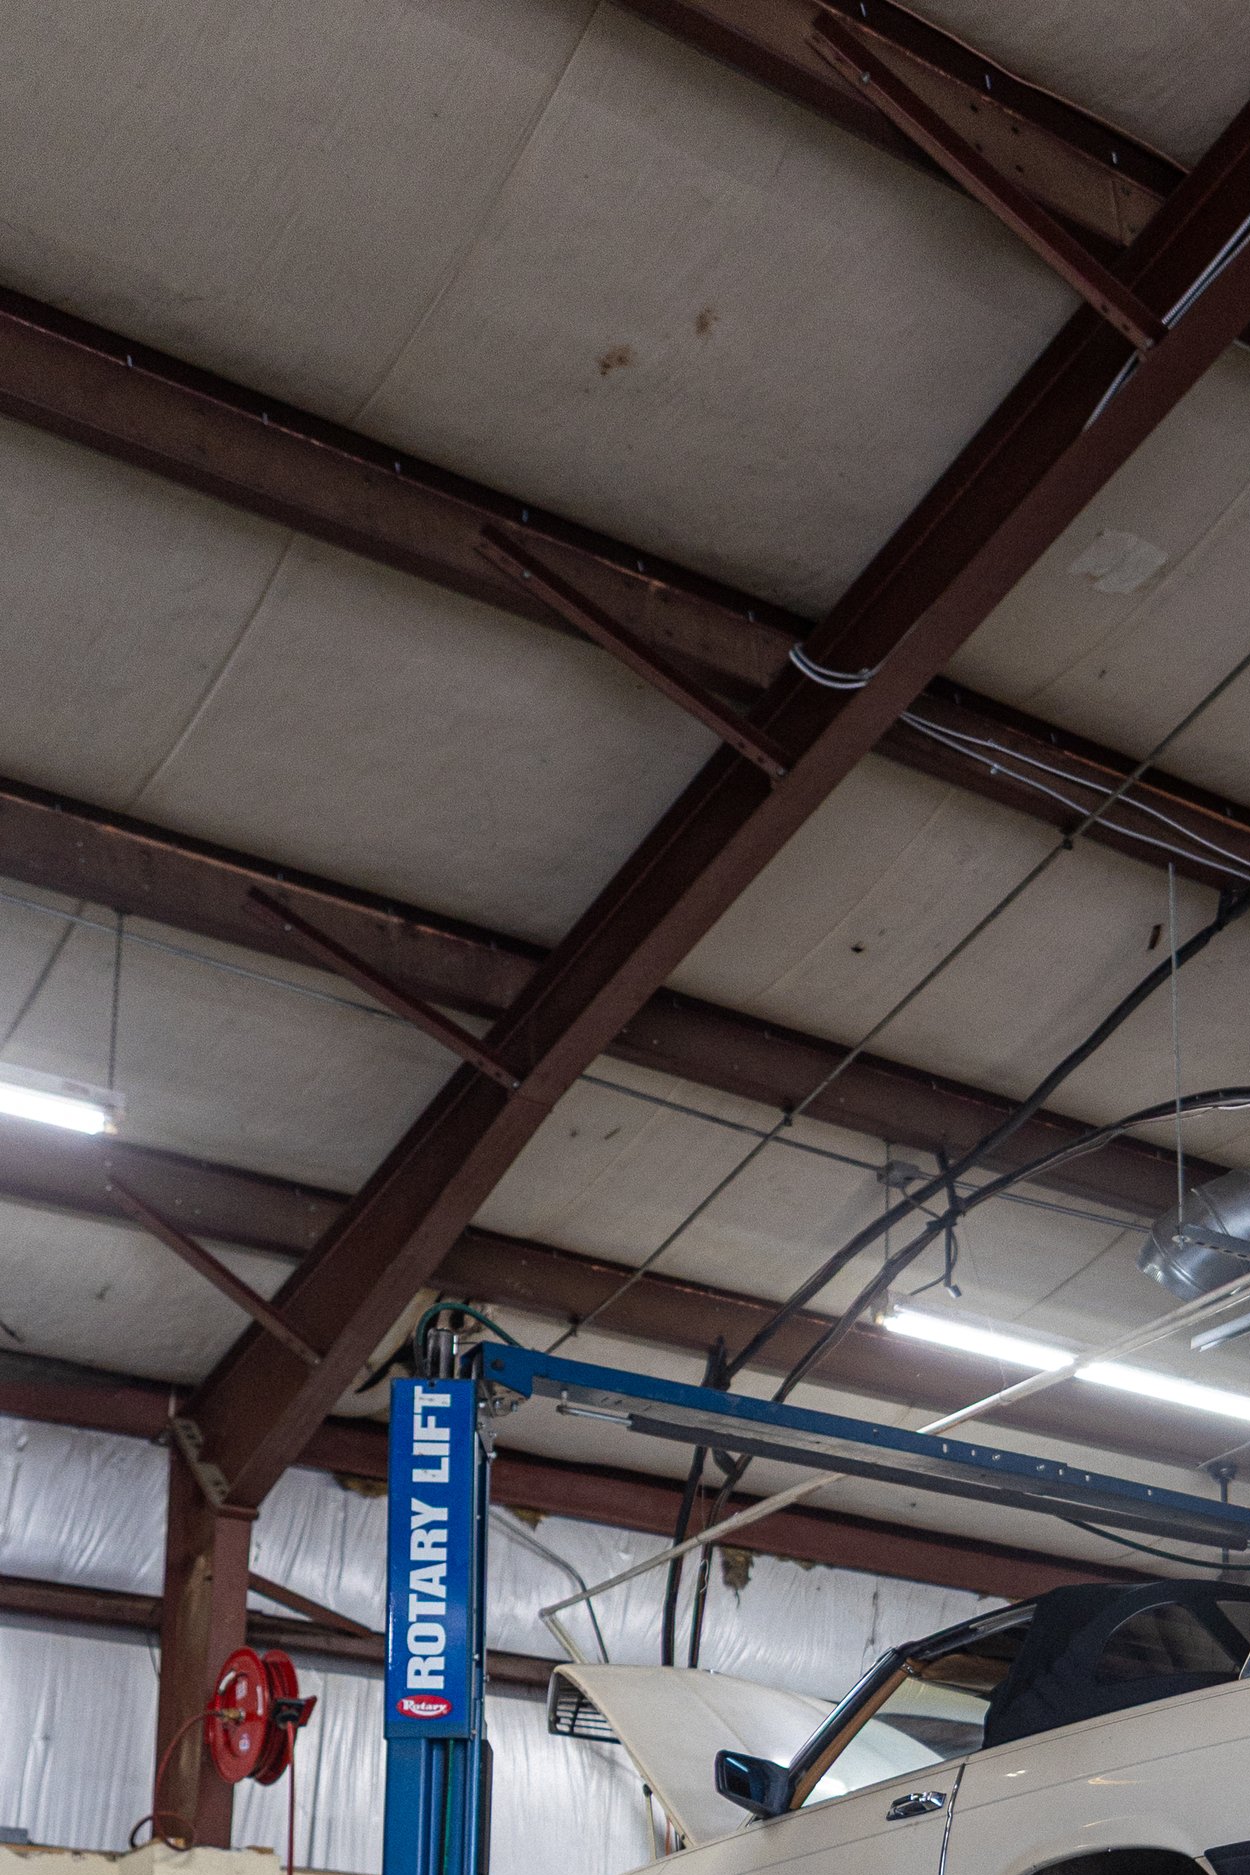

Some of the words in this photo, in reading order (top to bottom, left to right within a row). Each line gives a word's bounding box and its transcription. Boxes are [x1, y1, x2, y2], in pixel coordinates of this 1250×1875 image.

[411, 1385, 452, 1483] LIFT
[406, 1498, 449, 1690] ROTARY
[401, 1699, 448, 1716] Rotary
